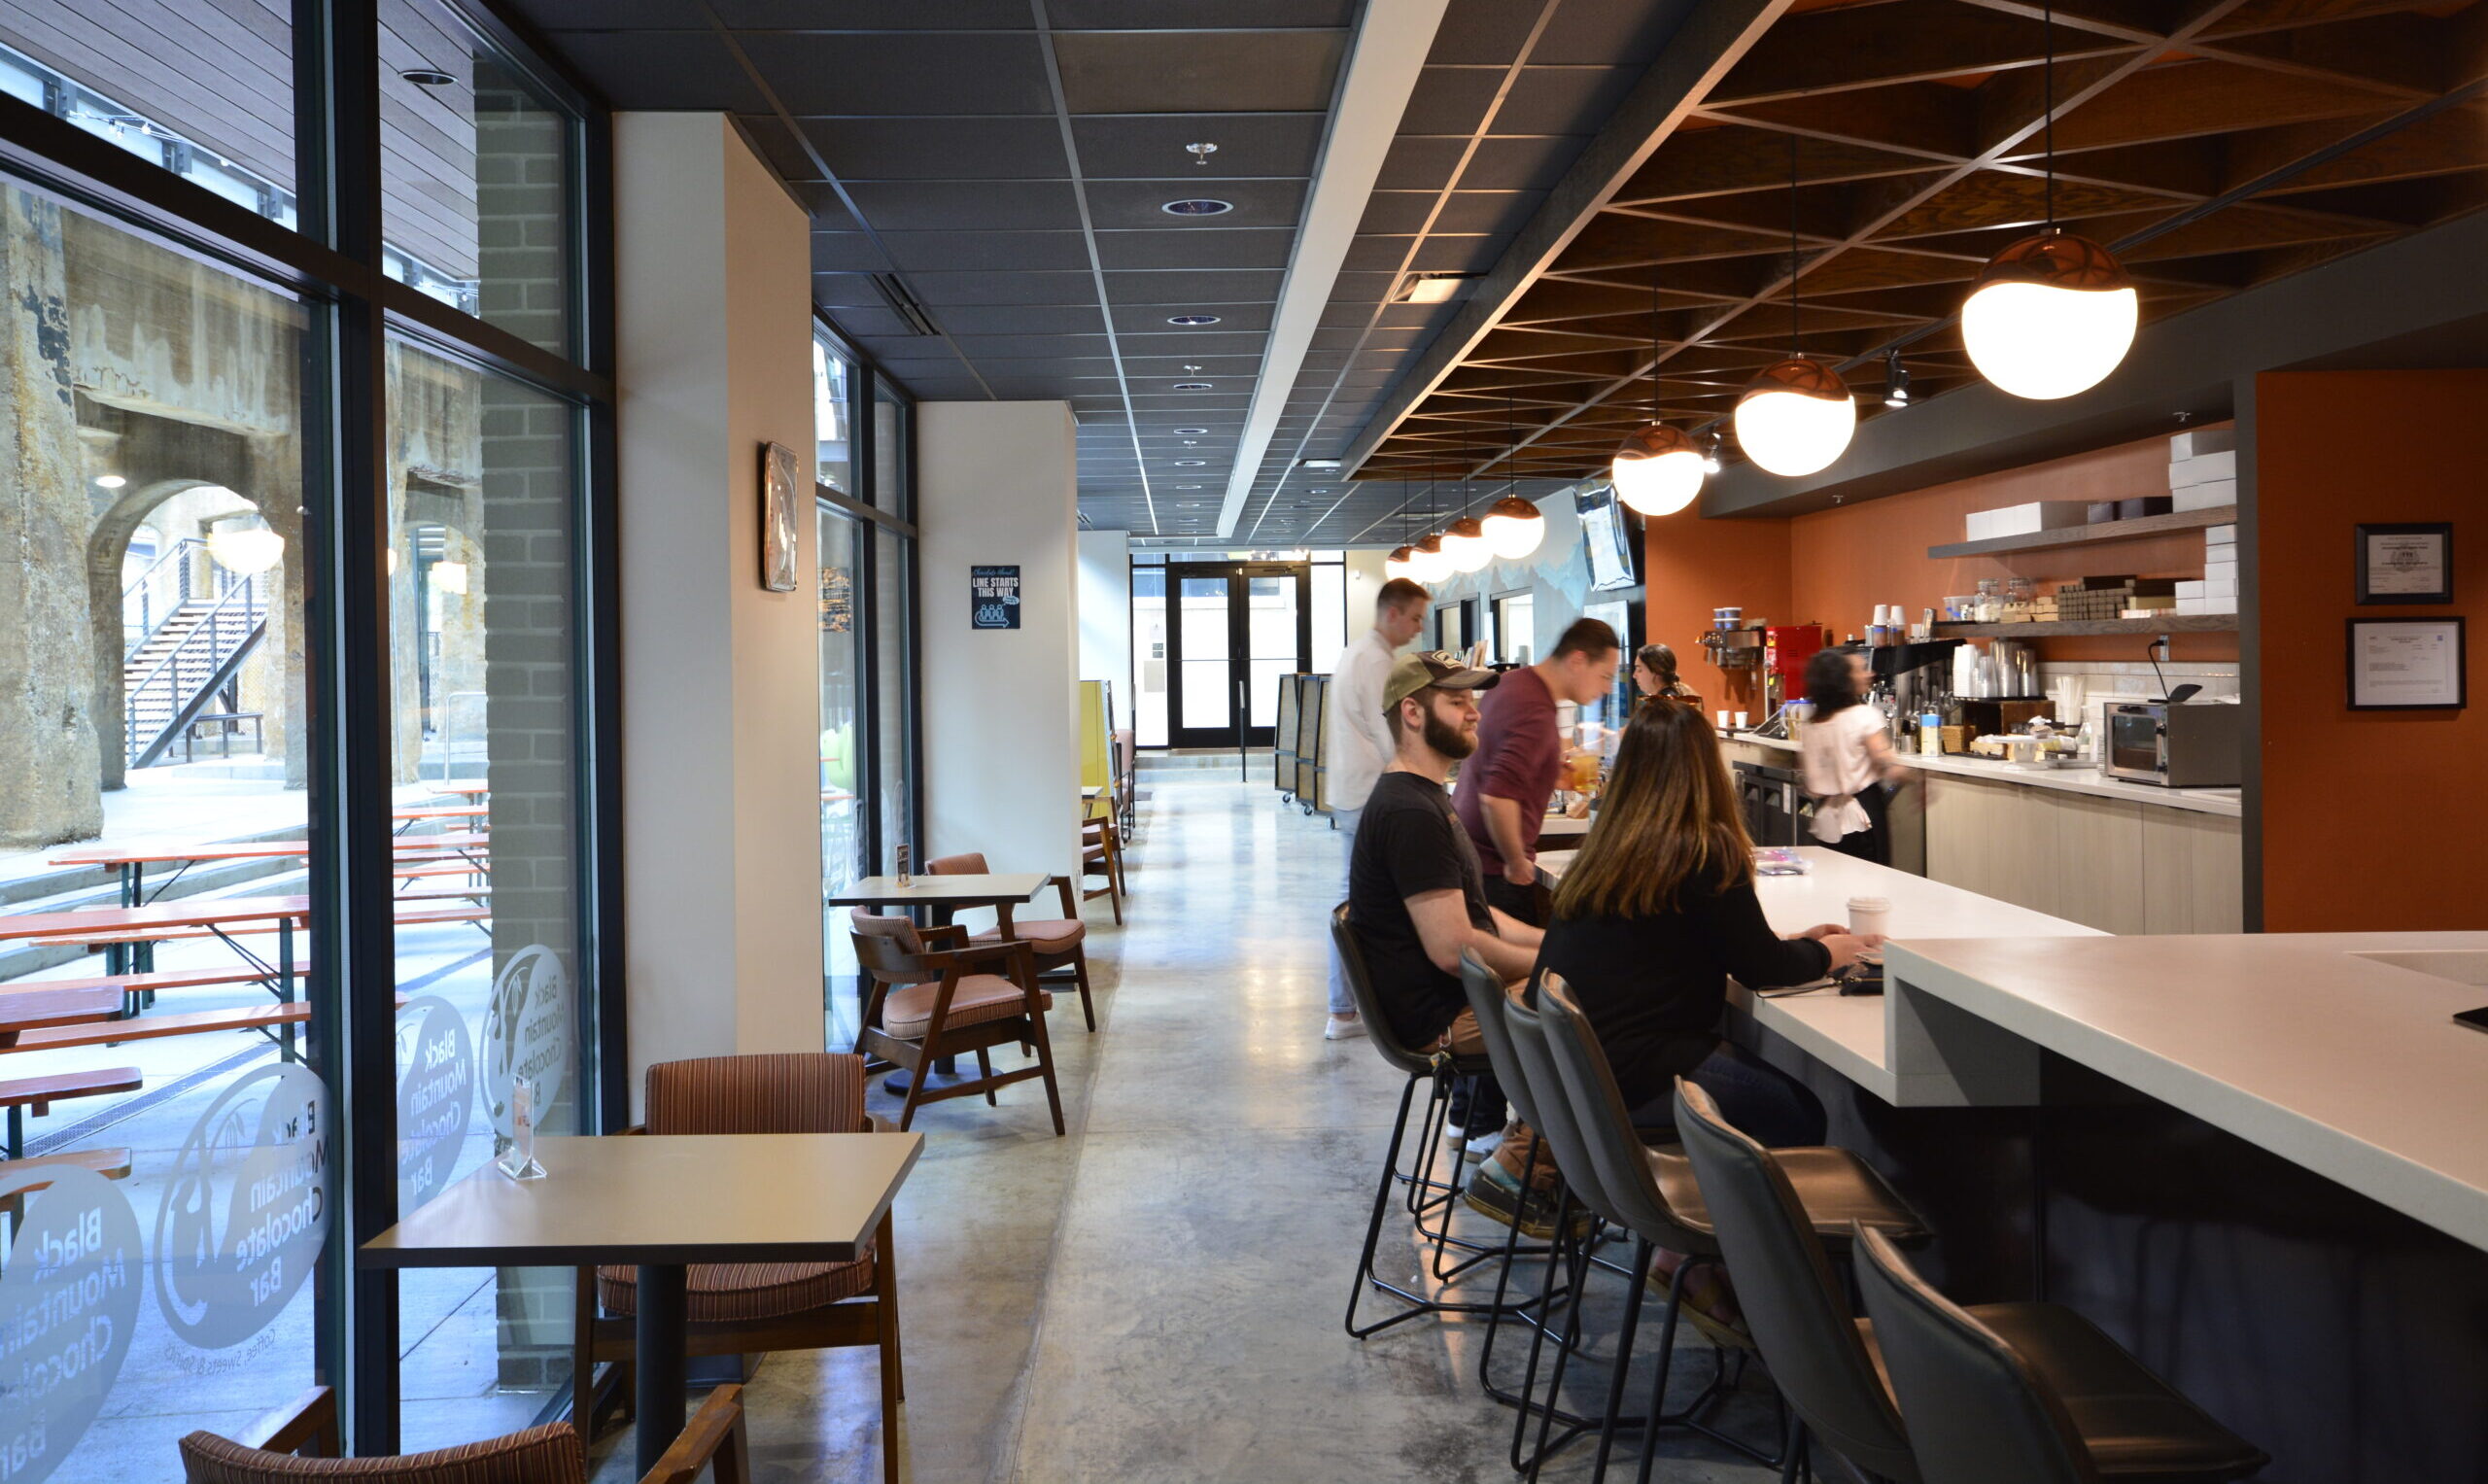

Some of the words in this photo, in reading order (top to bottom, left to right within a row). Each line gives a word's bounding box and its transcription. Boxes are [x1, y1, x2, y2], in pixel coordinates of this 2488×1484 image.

[973, 577, 988, 587] LINE
[990, 577, 1019, 587] STARTS
[978, 587, 994, 598] THIS
[996, 587, 1014, 598] WAY
